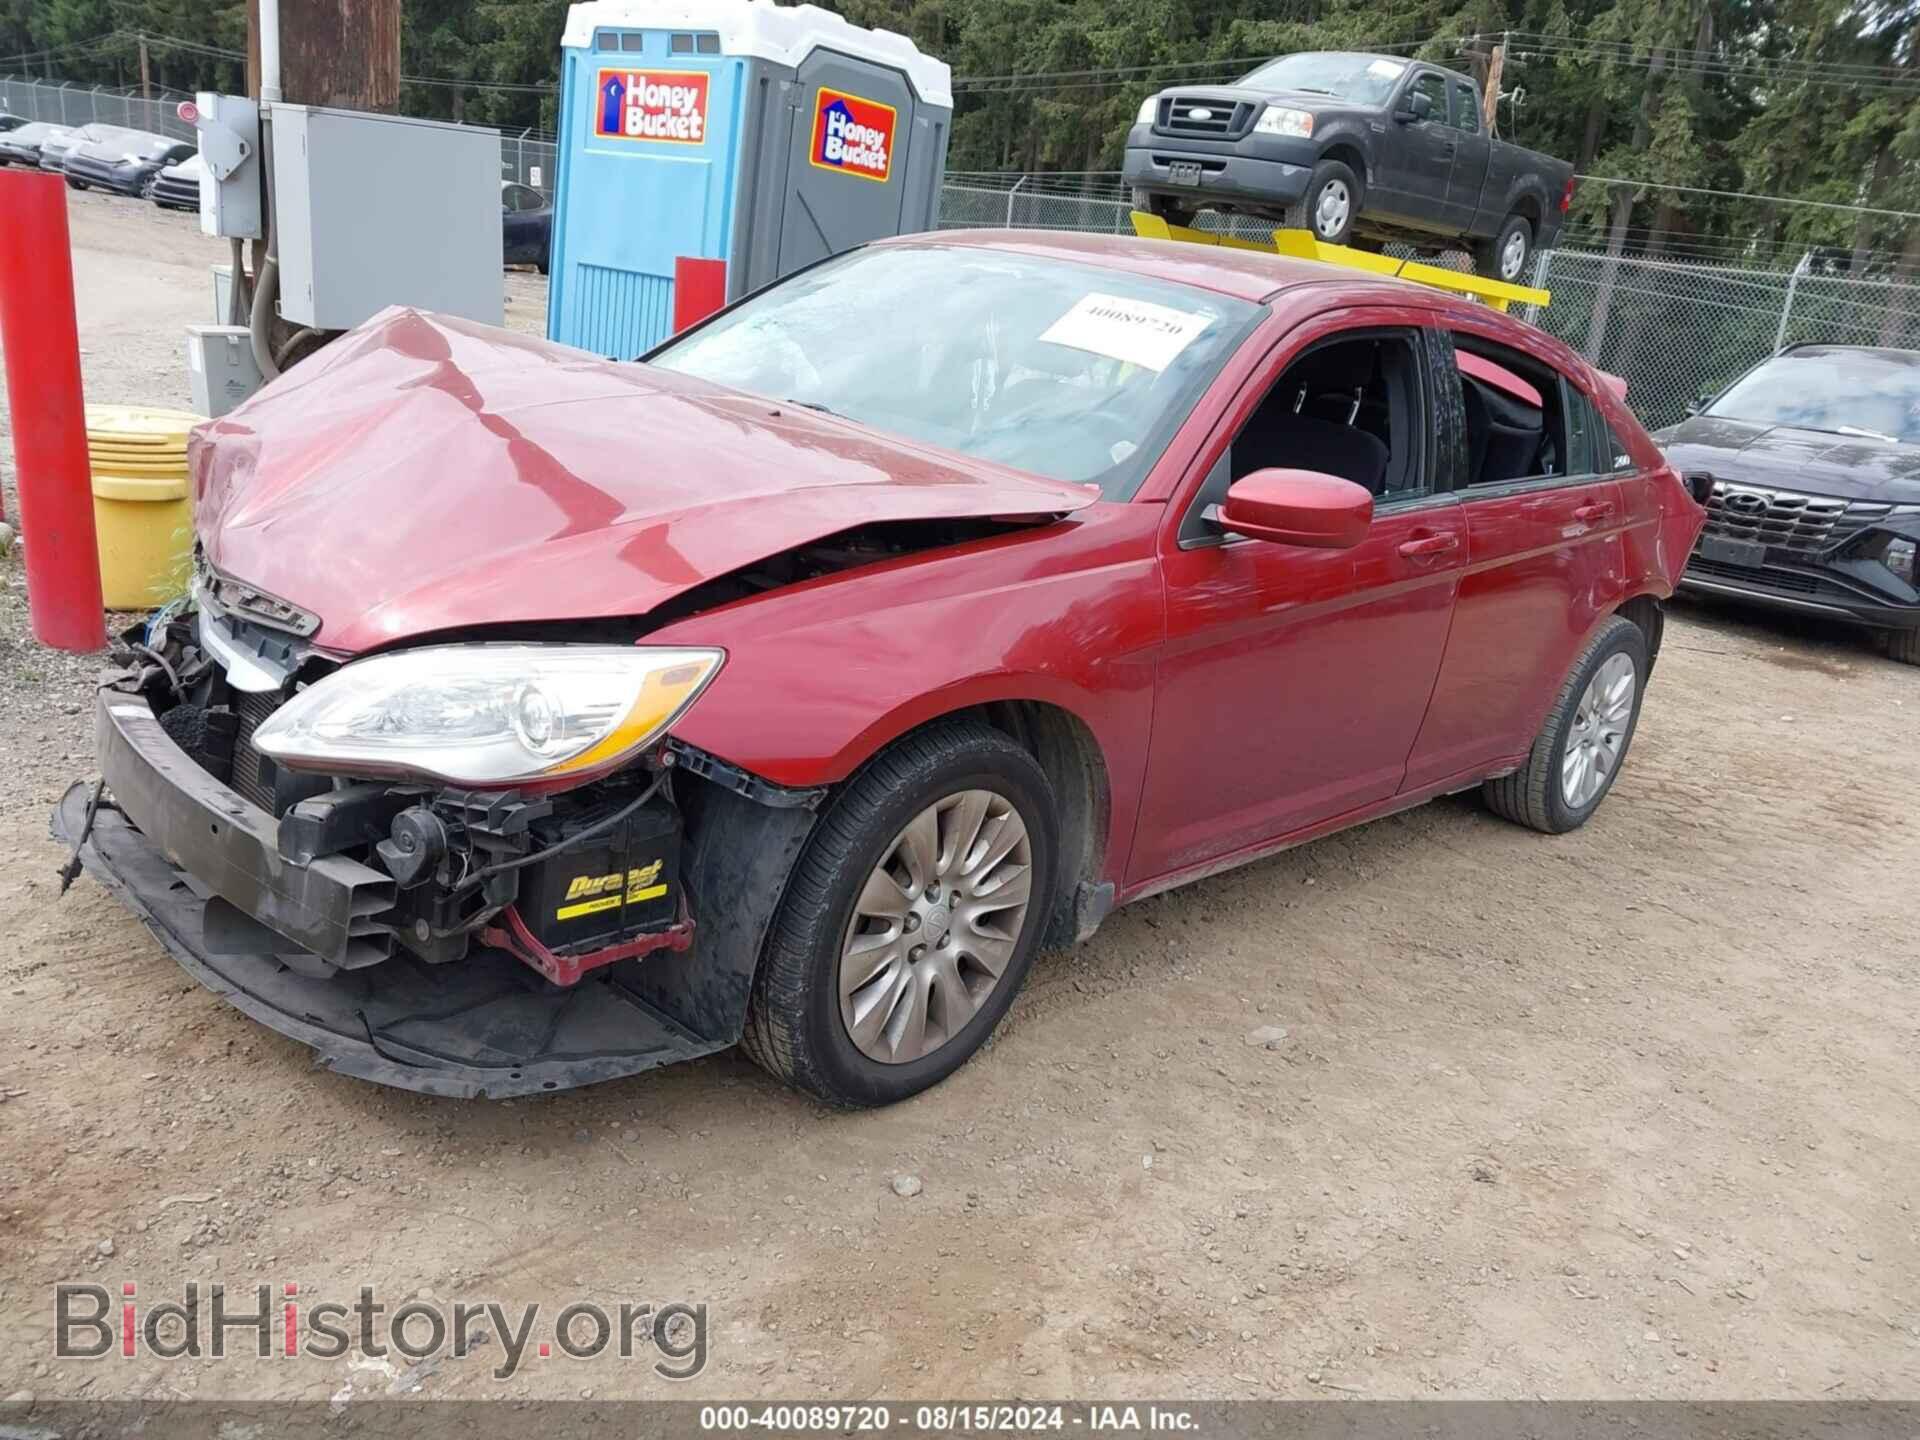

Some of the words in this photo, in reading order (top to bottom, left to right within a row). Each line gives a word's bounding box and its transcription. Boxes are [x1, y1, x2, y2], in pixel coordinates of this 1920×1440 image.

[626, 74, 698, 115] Honey
[625, 106, 702, 139] Bucket
[828, 110, 886, 152] Honey
[824, 135, 888, 171] Bucket
